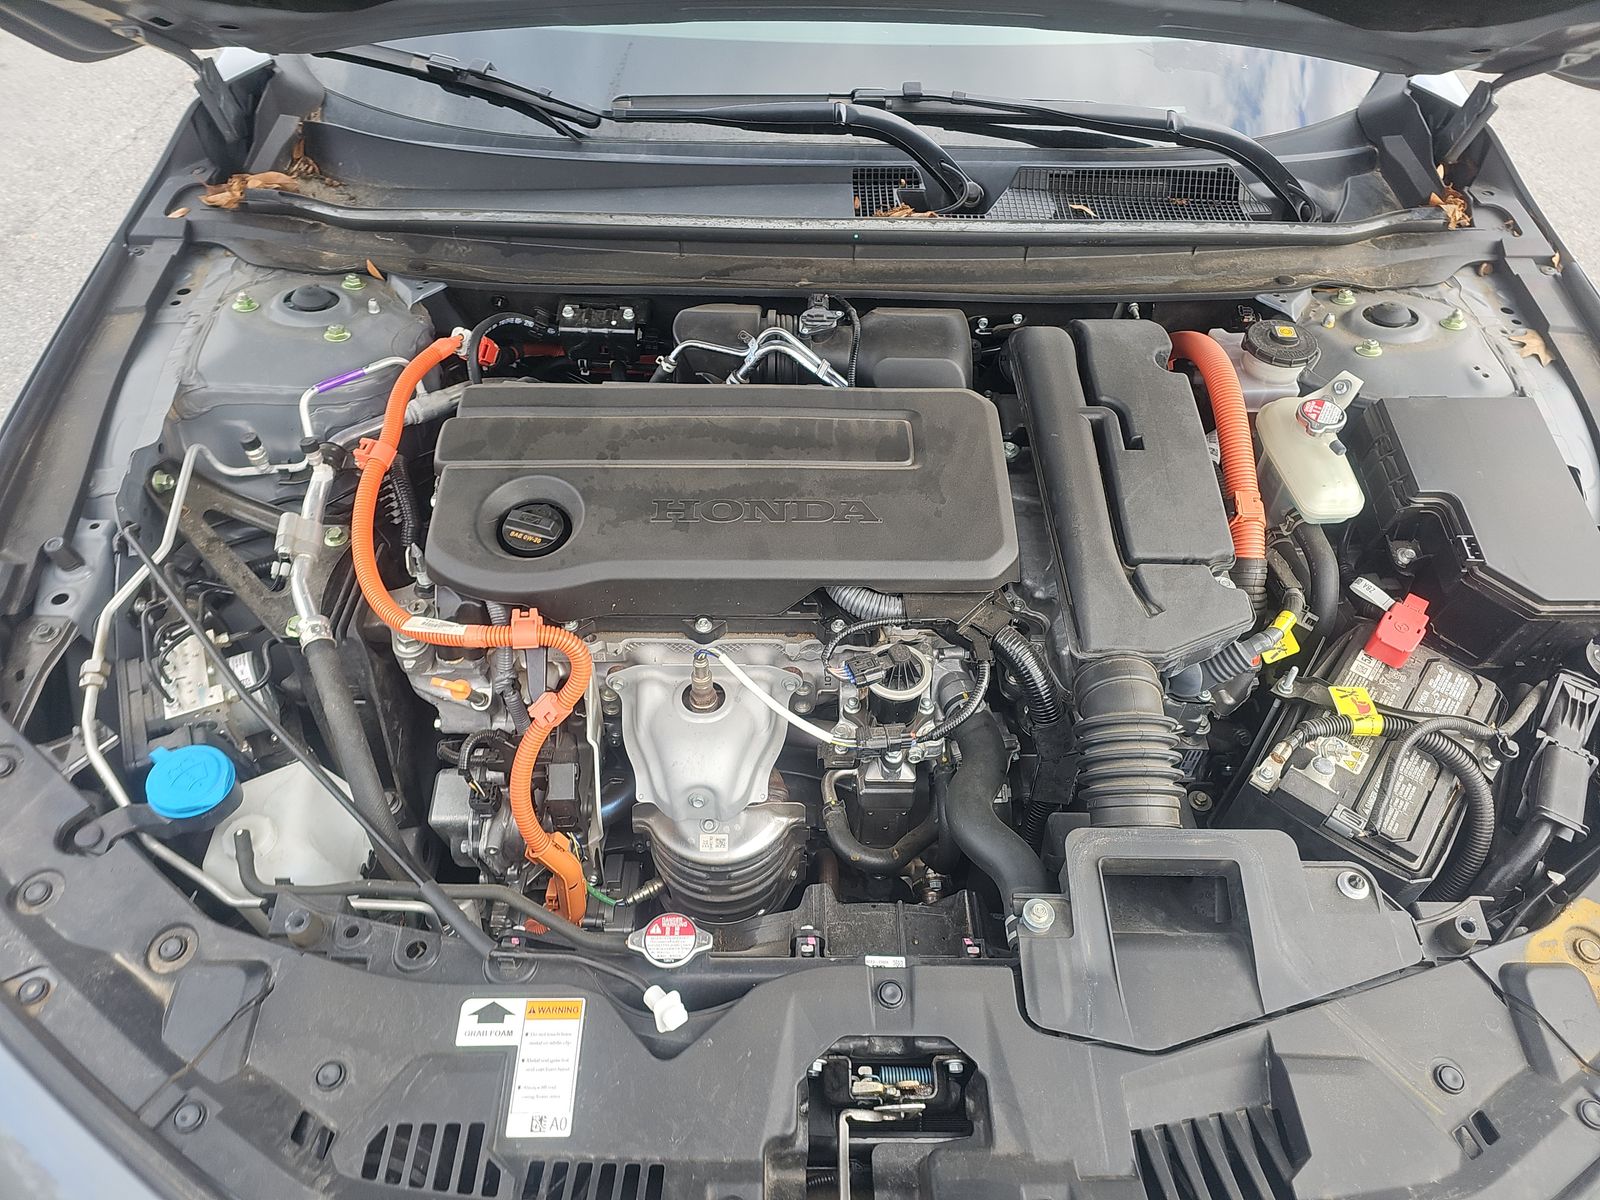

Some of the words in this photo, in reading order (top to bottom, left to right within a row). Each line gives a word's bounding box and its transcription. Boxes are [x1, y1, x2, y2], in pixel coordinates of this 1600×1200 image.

[650, 499, 883, 524] HONDA
[538, 1006, 579, 1014] WARNING
[549, 1116, 568, 1132] A0
